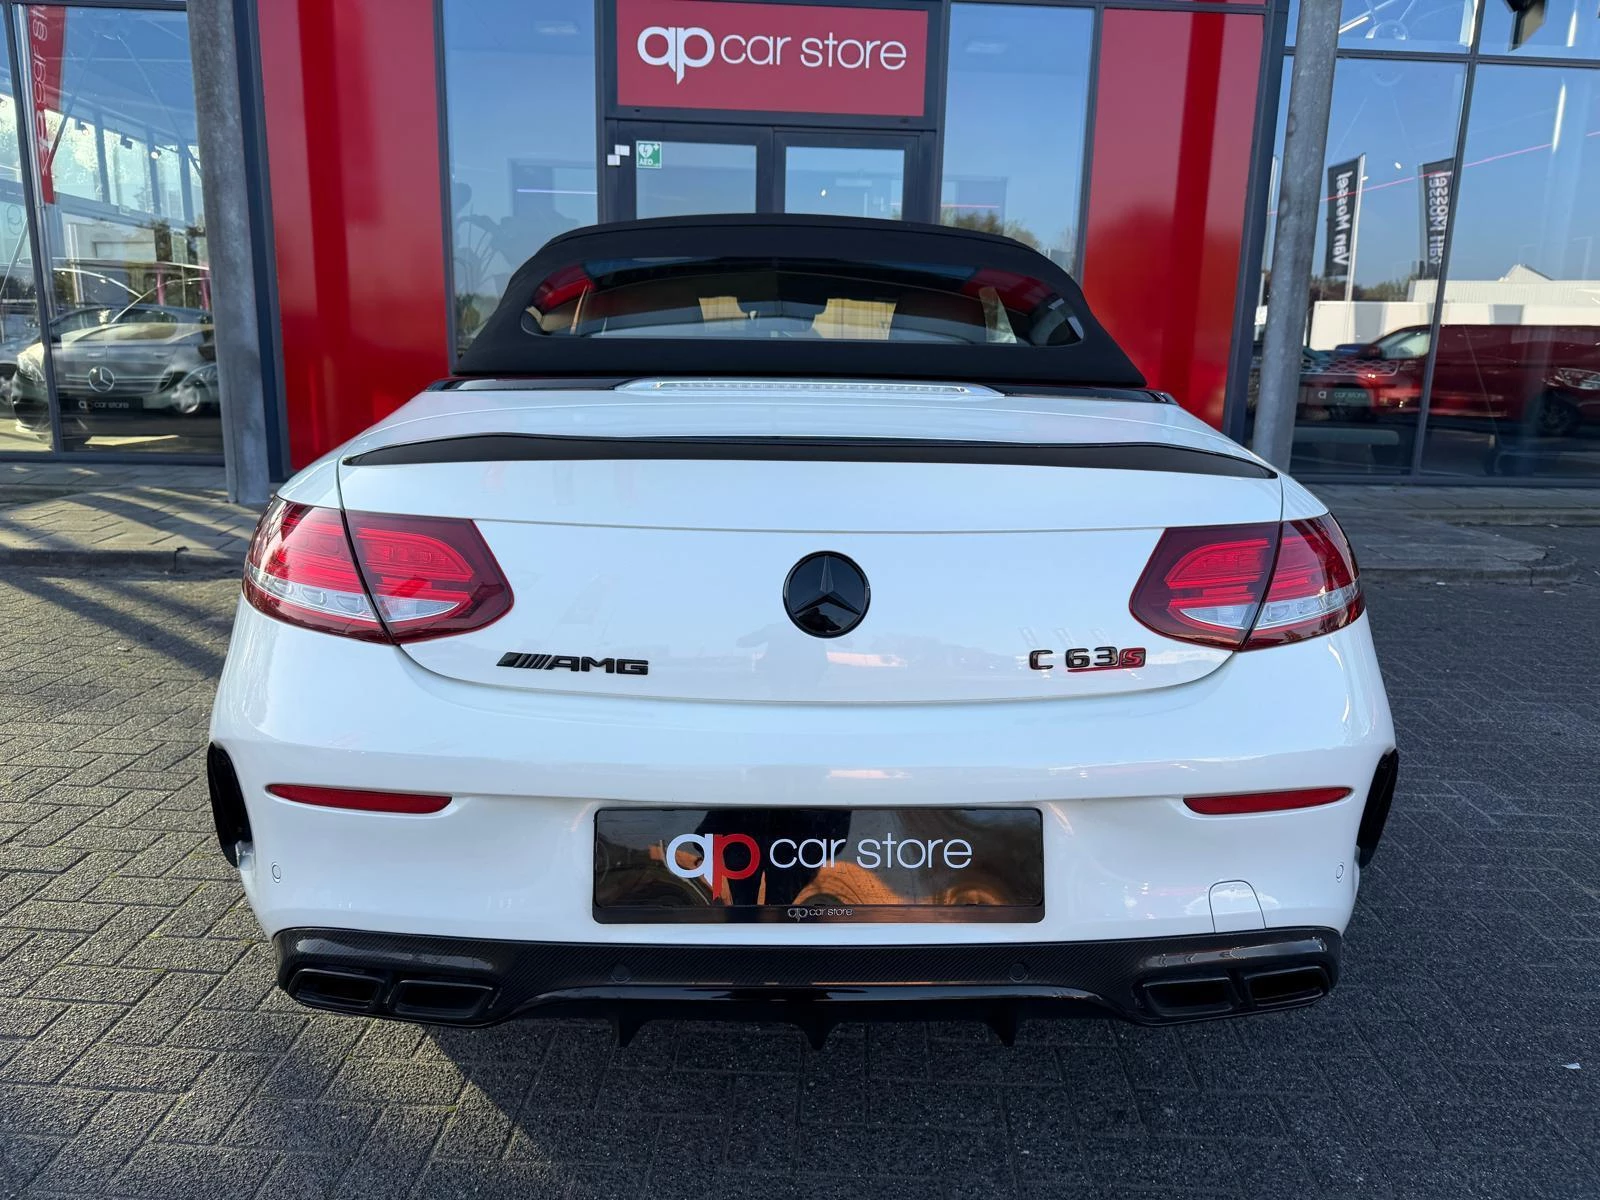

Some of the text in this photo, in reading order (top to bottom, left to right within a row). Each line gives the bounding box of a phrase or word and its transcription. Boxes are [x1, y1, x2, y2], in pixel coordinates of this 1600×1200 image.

[637, 26, 907, 85] ap car store
[639, 158, 654, 166] AED
[1029, 649, 1054, 671] C
[666, 832, 973, 900] ap car store
[809, 908, 826, 916] car
[827, 907, 853, 916] store
